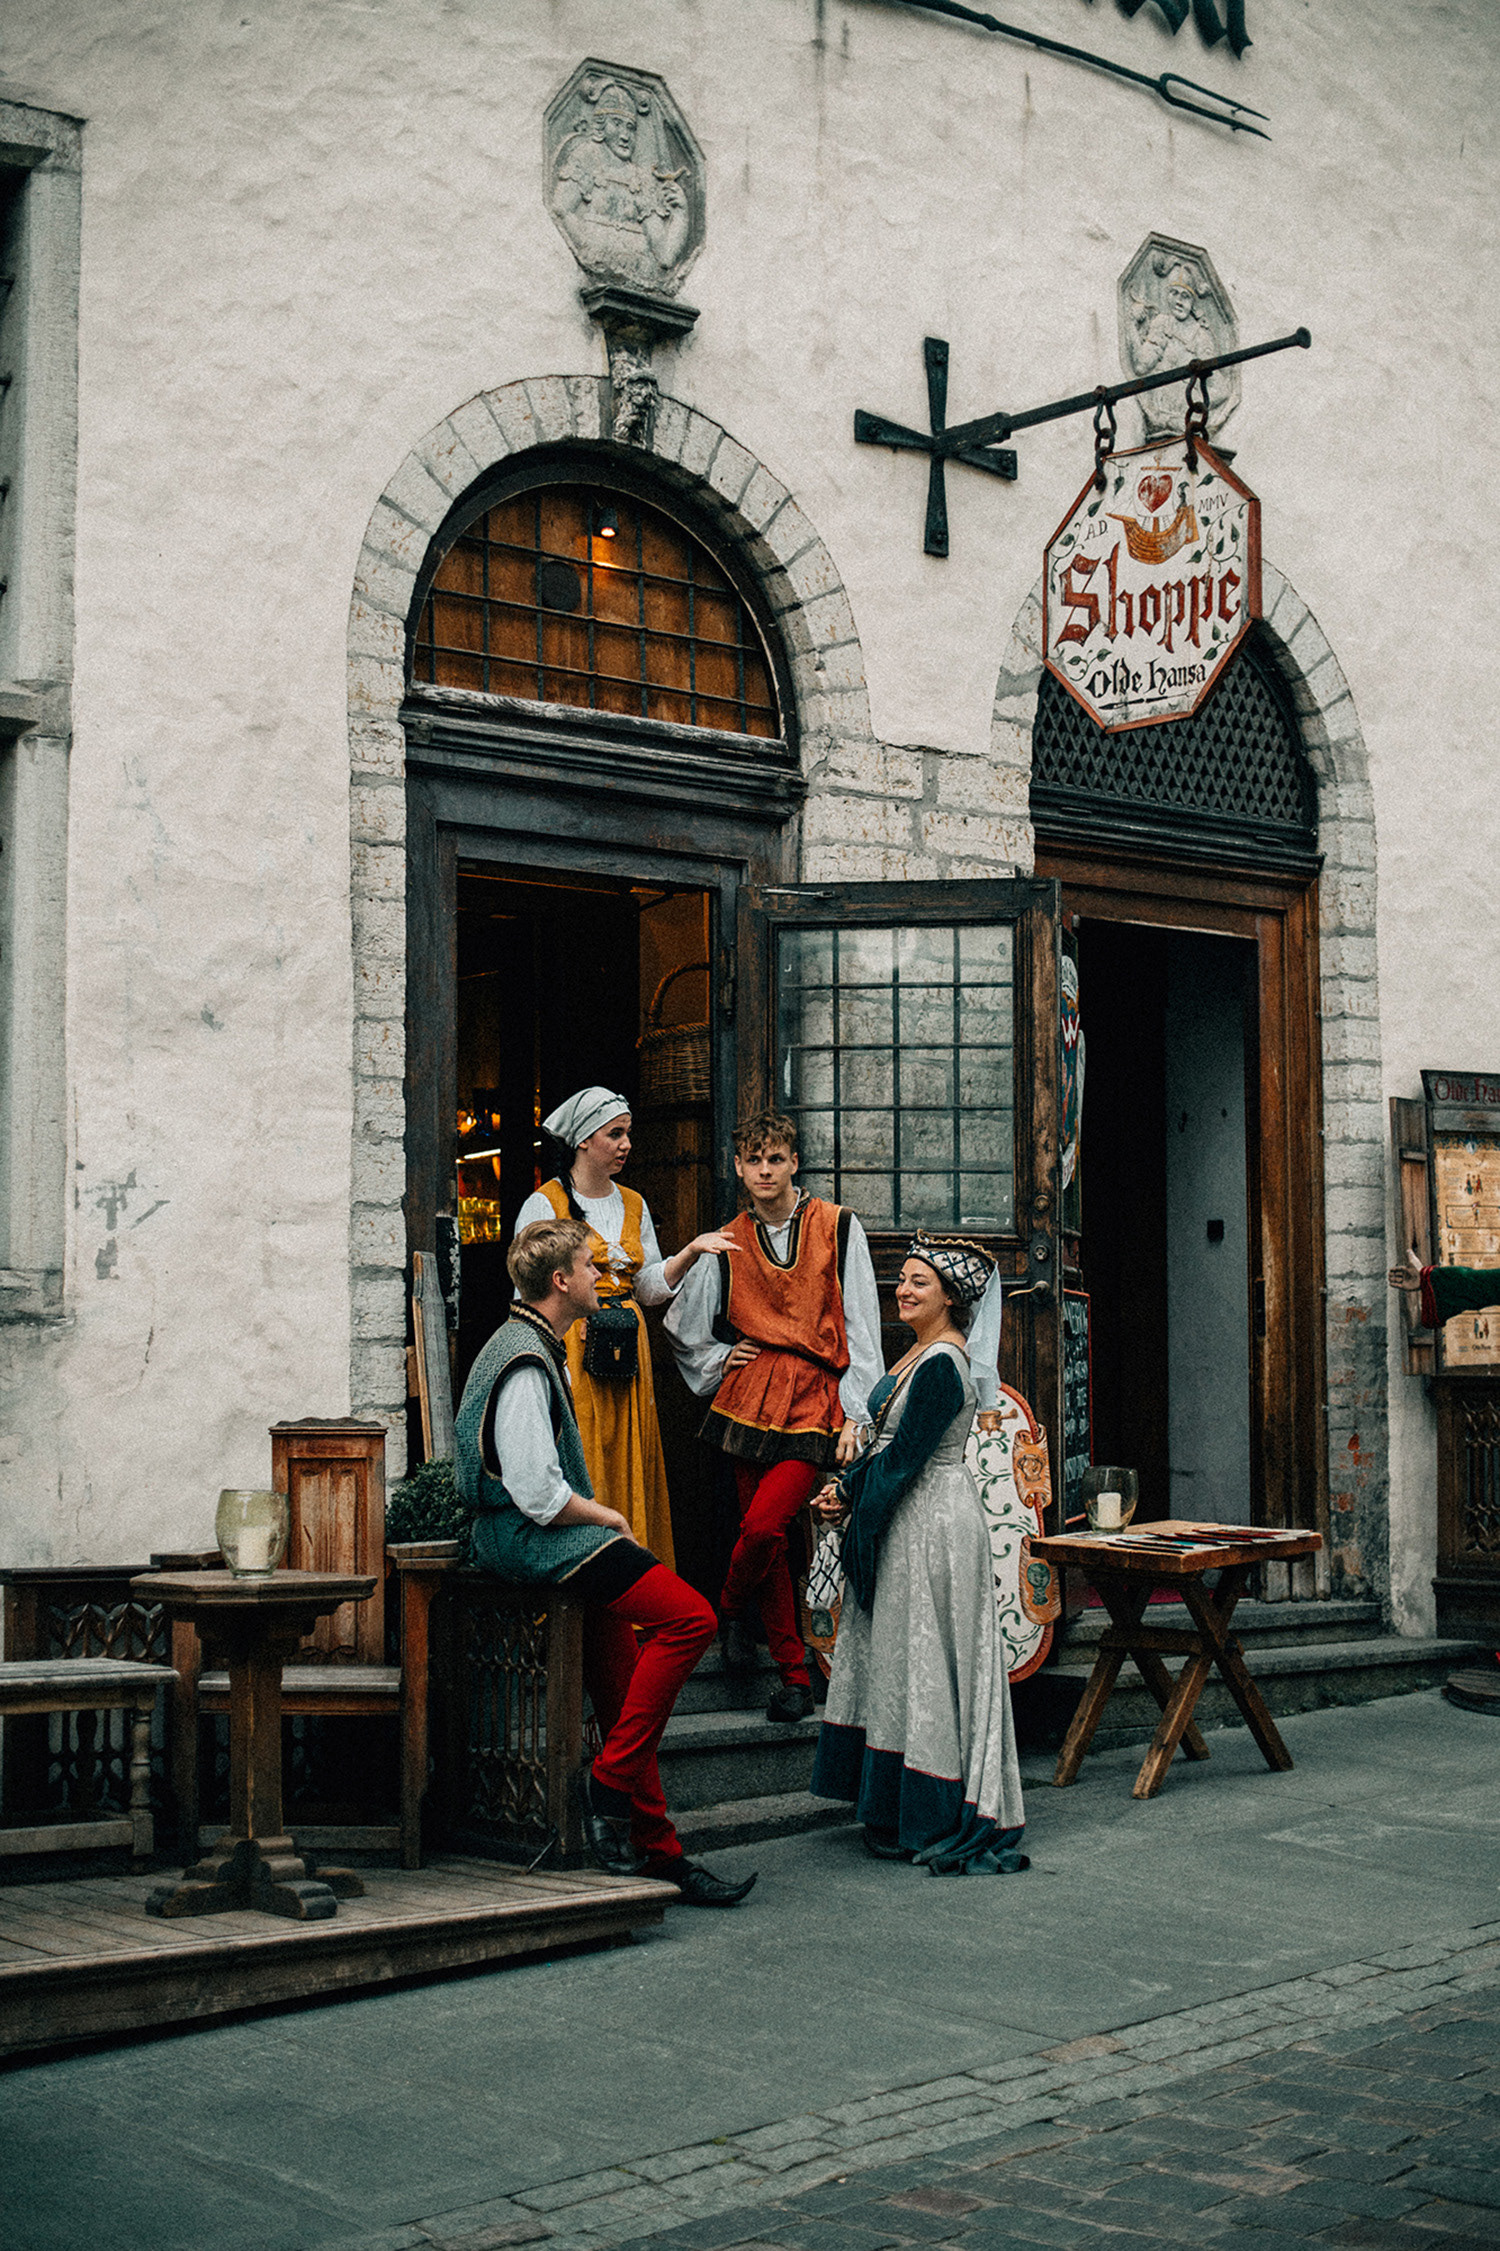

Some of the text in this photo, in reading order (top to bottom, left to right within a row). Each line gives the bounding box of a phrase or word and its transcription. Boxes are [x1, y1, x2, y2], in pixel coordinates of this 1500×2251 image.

[1053, 541, 1241, 654] Shoppe
[1085, 657, 1143, 698] Olde
[1434, 1077, 1469, 1102] Olde
